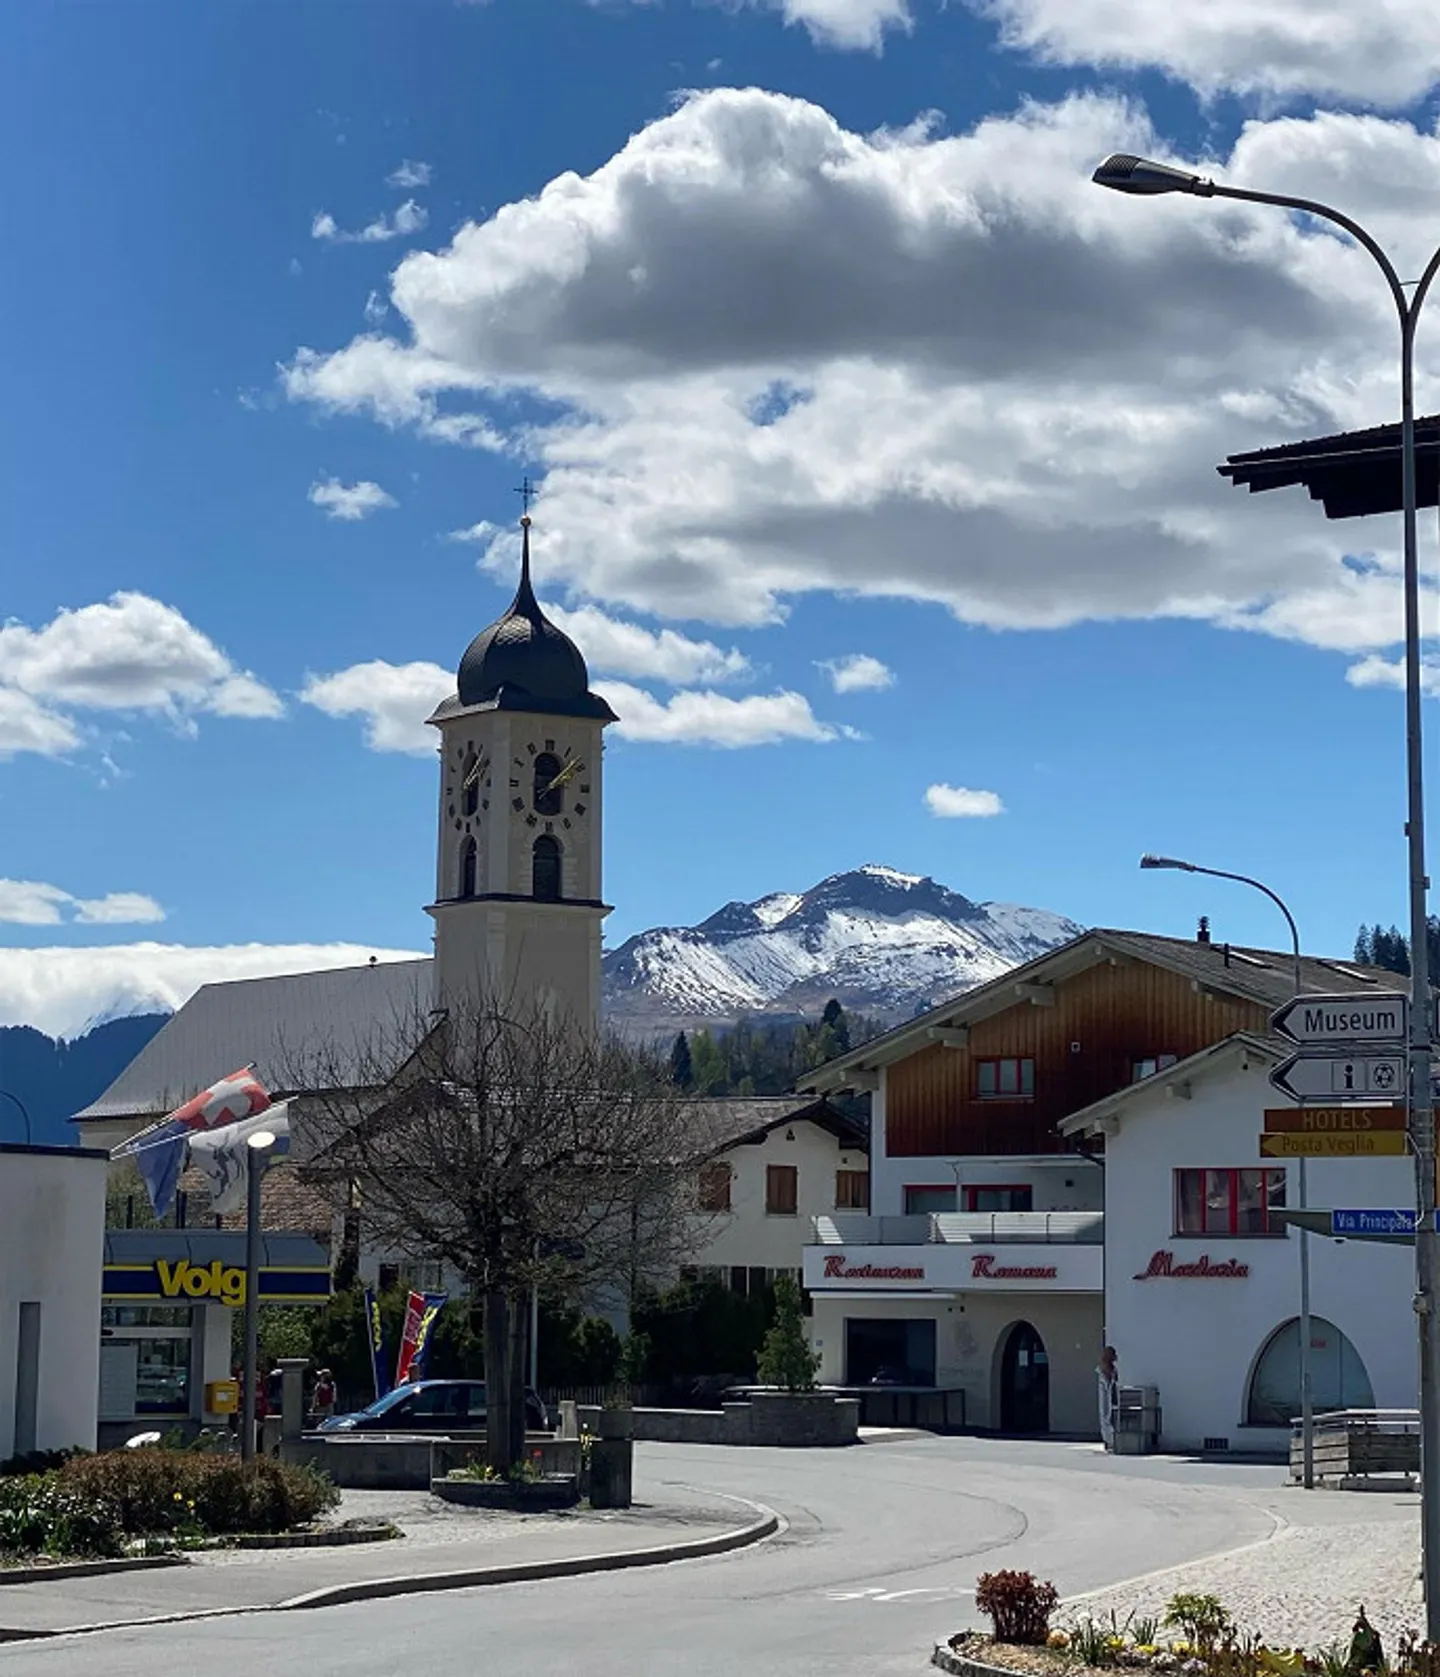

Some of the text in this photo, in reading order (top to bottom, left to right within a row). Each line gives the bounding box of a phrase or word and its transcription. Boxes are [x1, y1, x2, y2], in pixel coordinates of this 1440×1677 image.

[1305, 1009, 1395, 1032] Museum
[1303, 1109, 1372, 1130] HOTELS
[1282, 1134, 1374, 1154] Posta Veglia
[1337, 1211, 1356, 1229] Via
[156, 1258, 246, 1306] Volg
